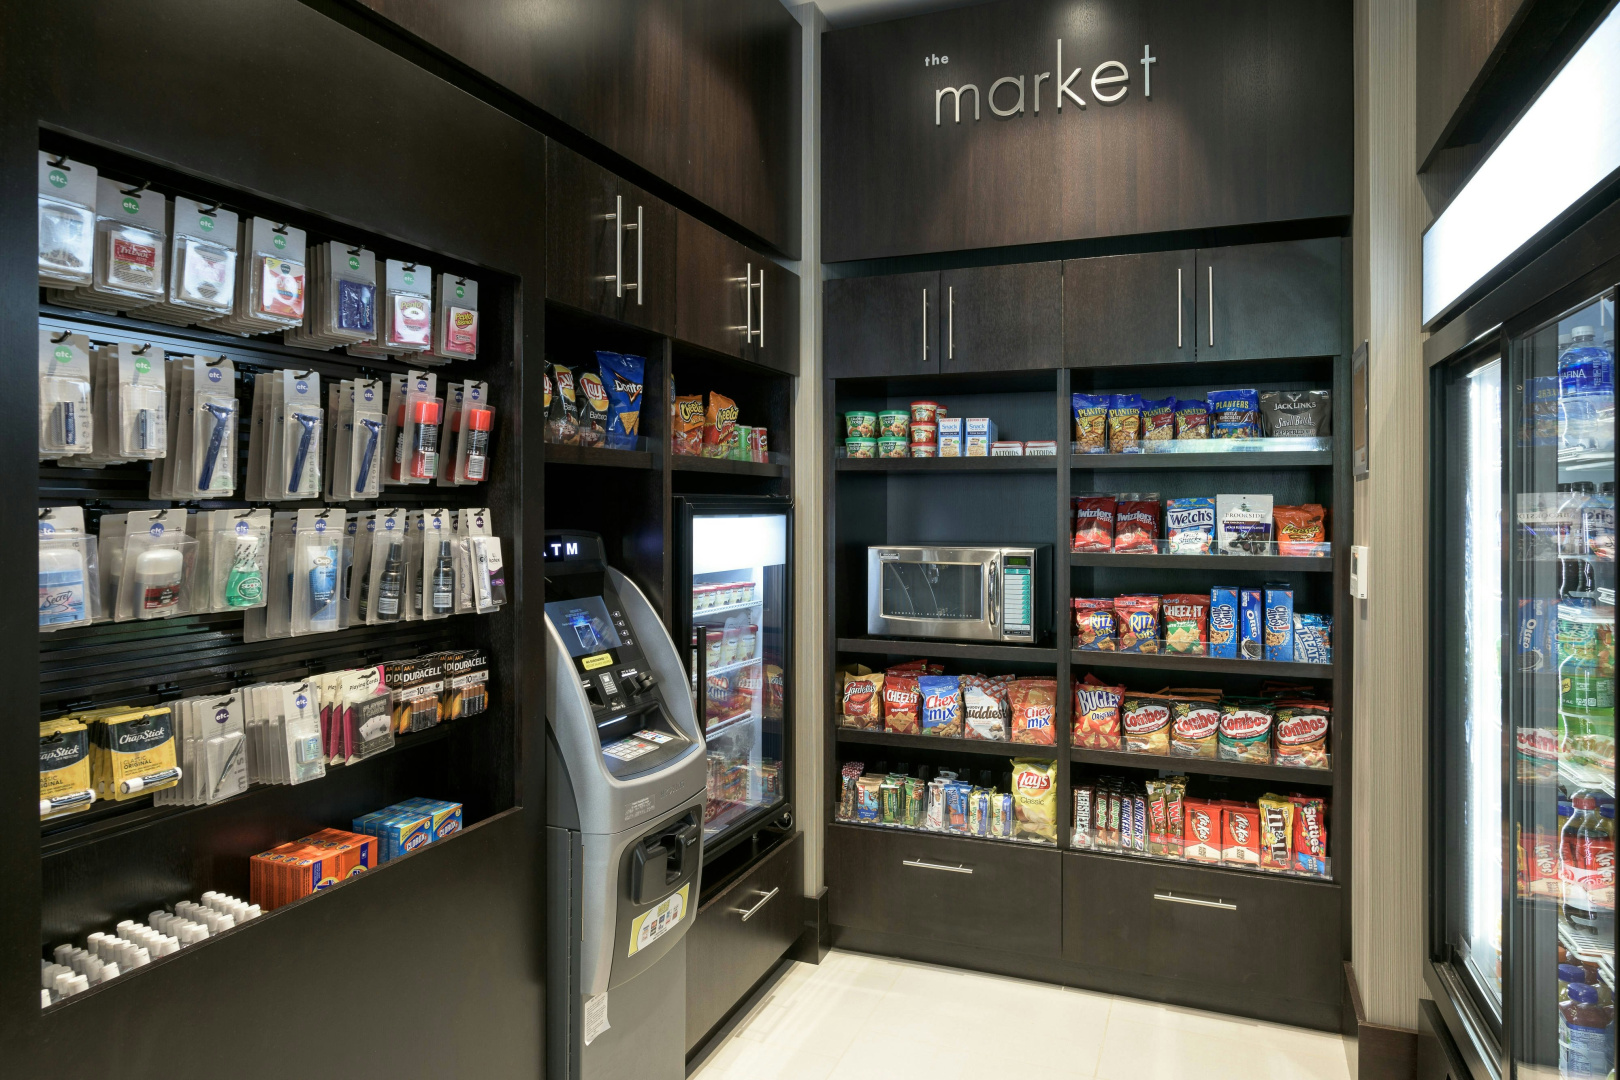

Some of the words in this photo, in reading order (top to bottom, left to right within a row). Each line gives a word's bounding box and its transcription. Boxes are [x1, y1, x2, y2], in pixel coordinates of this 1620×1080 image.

[924, 53, 949, 66] the
[935, 38, 1157, 126] market
[49, 173, 68, 185] etc.
[122, 200, 140, 211] etc.
[199, 218, 214, 229] etc.
[273, 238, 286, 247] etc.
[349, 259, 360, 268] etc.
[403, 275, 414, 283] etc.
[455, 288, 465, 296] etc.
[55, 350, 72, 359] etc.
[135, 361, 151, 370] etc.
[208, 371, 222, 379] etc.
[1562, 368, 1587, 379] AFINA
[296, 383, 309, 391] etc.
[1216, 400, 1249, 410] PLANTERS
[1274, 402, 1294, 411] JACK
[1078, 407, 1108, 418] PLANTERS
[1109, 408, 1140, 417] PLANTERS
[1142, 407, 1172, 418] PLANTERS
[1175, 408, 1206, 417] PLANTERS
[942, 423, 959, 431] Snack
[969, 423, 987, 431] Snack
[1275, 415, 1295, 428] Small
[1078, 508, 1112, 519] Twizzlers
[1117, 510, 1152, 522] Twizzlers
[1170, 510, 1213, 526] Welch's
[235, 524, 250, 532] etc.
[544, 542, 578, 556] TM
[44, 591, 73, 608] Secret
[1090, 613, 1112, 628] RITZ
[1129, 613, 1152, 629] RITZ
[1220, 604, 1231, 626] Chips
[1274, 605, 1287, 626] Chips
[1246, 609, 1257, 638] OREO
[1095, 627, 1113, 637] bits
[1136, 628, 1154, 640] bits
[1308, 625, 1318, 638] RICE
[1316, 637, 1327, 664] KRISPIE
[454, 656, 487, 671] DURACELL
[403, 666, 441, 682] DURACELL
[466, 675, 472, 683] 10
[416, 686, 424, 695] 10
[926, 692, 958, 709] Chex
[1077, 689, 1121, 716] BUGLES
[215, 711, 229, 721] etc.
[929, 705, 957, 721] mix
[1025, 705, 1053, 719] Chex
[1124, 708, 1168, 728] Combos
[1027, 714, 1052, 730] mix
[1177, 712, 1219, 733] Combos
[1220, 712, 1268, 731] Combos
[1279, 717, 1326, 738] Combos
[119, 727, 165, 745] ChapStick
[40, 744, 80, 761] apStick
[123, 755, 146, 764] CLASSIC
[123, 759, 152, 770] ORIGINAL
[40, 775, 58, 783] ASSIC
[40, 780, 63, 788] IGINAL
[1020, 796, 1045, 806] Classic
[1121, 797, 1132, 837] SNICKERS
[1134, 798, 1144, 840] SNICKERS
[439, 820, 456, 837] CLOROX
[1303, 805, 1320, 854] Skittles
[406, 833, 425, 851] CLOROX
